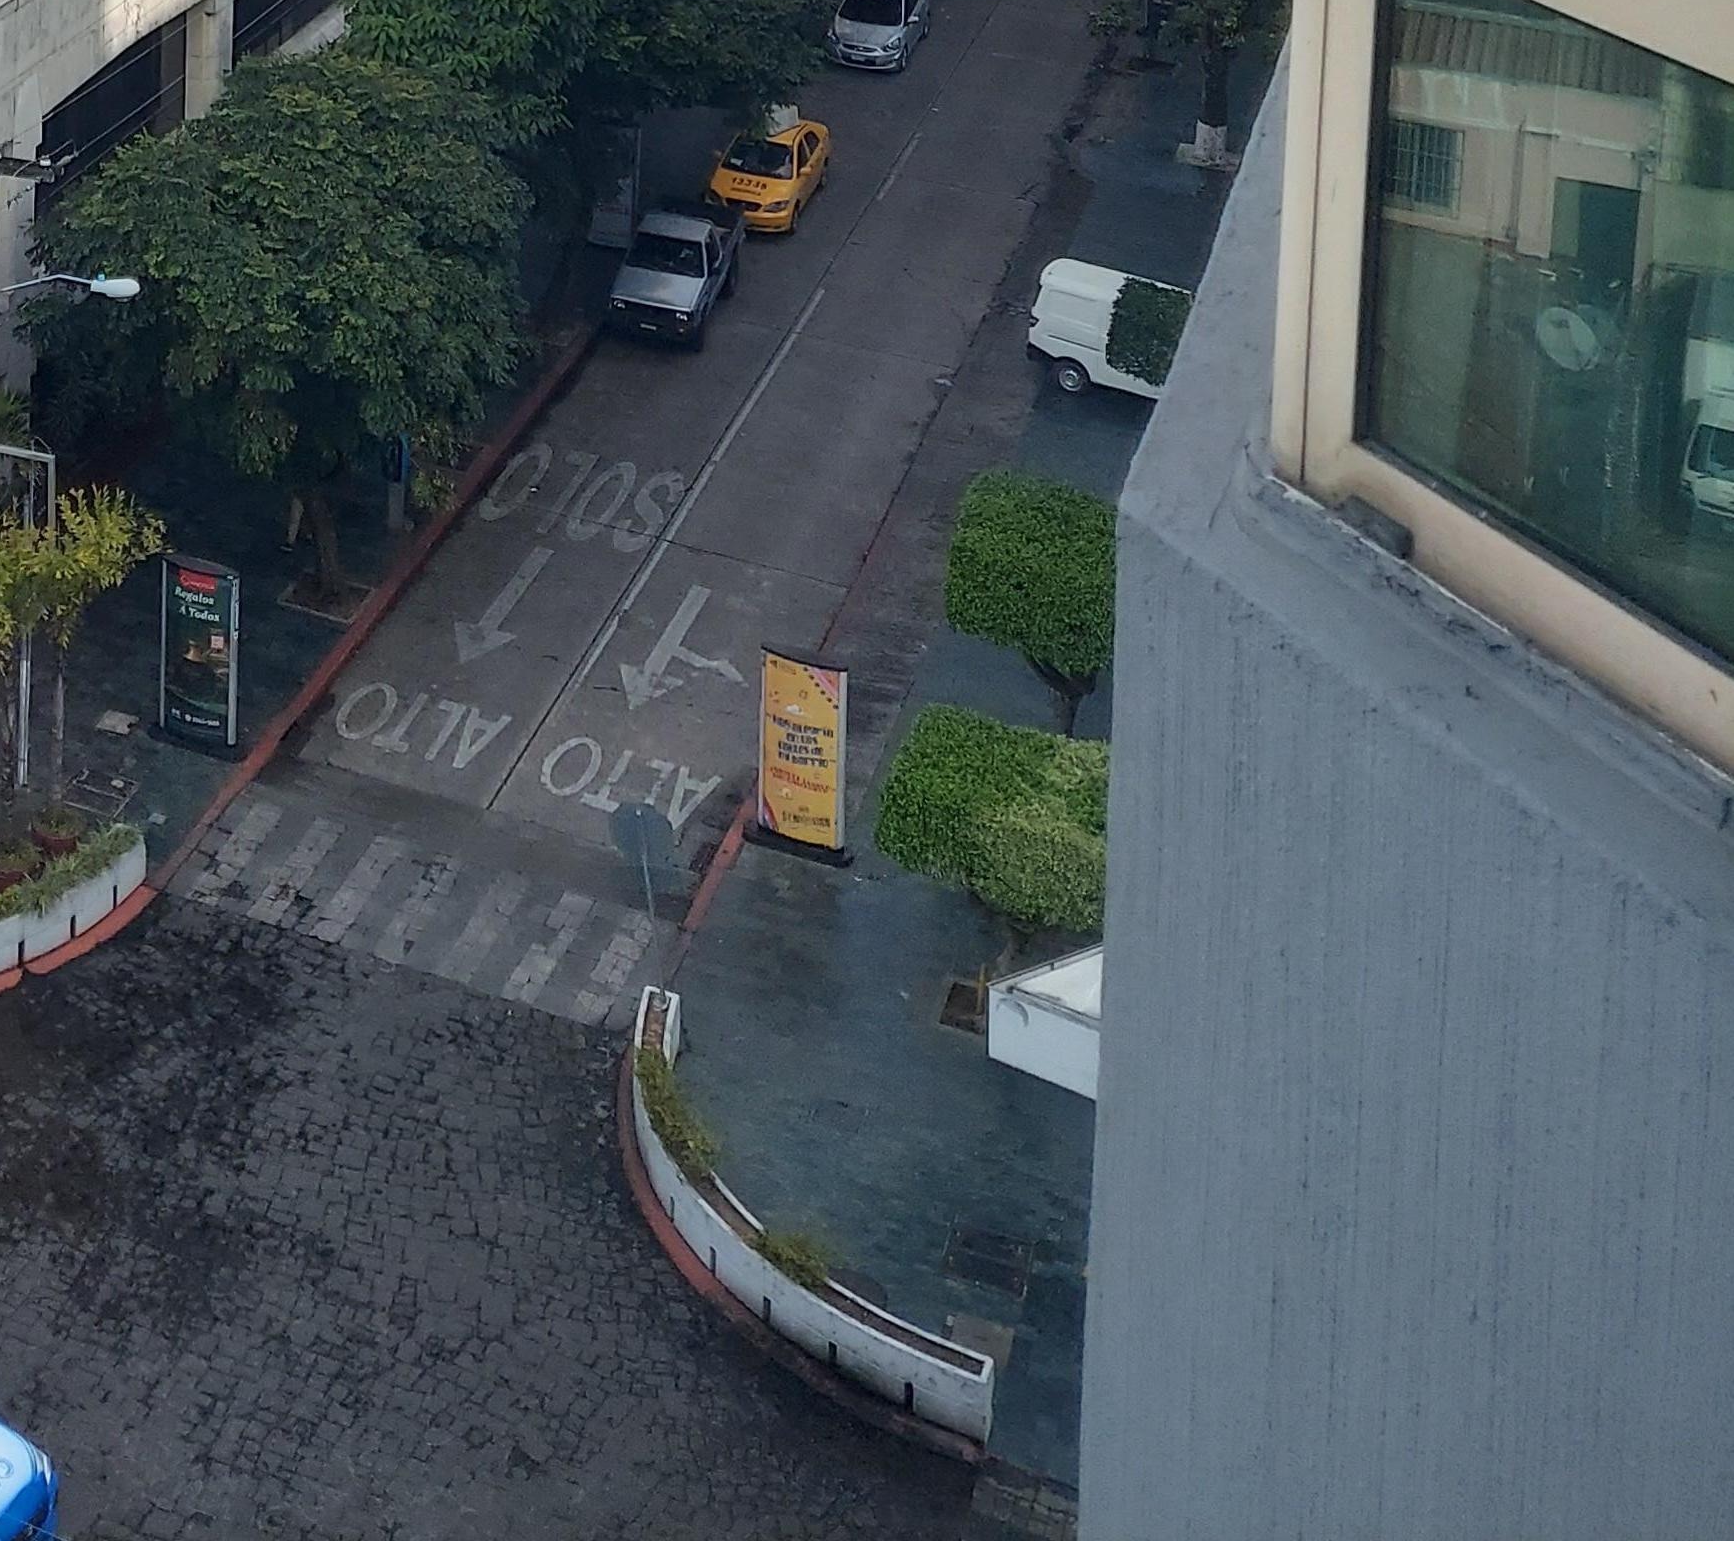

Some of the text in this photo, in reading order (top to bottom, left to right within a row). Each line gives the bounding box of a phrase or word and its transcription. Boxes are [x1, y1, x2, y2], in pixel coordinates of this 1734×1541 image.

[479, 443, 685, 553] SOLO
[336, 682, 513, 769] ALTO
[540, 736, 723, 831] ALTO
